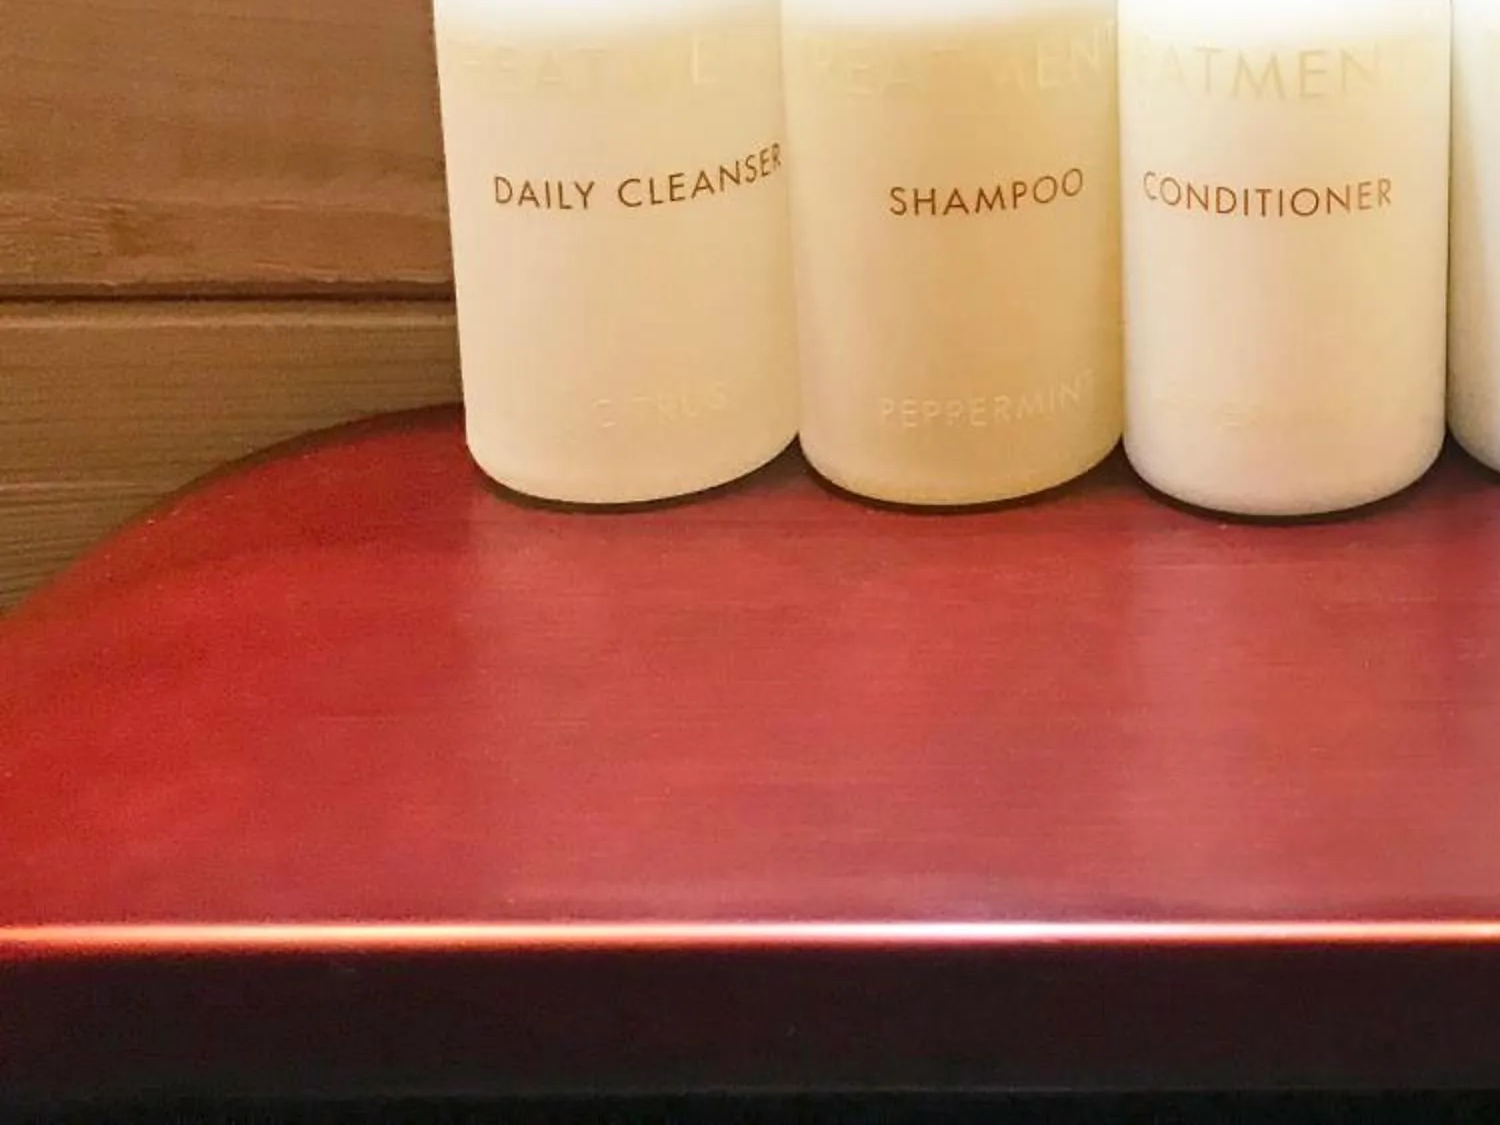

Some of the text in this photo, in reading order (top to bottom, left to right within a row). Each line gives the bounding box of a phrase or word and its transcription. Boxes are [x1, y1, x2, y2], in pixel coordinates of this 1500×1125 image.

[494, 142, 782, 211] DAILY CLEANSER
[889, 168, 1084, 217] SHAMPOO
[1143, 171, 1393, 217] CONDITIONER
